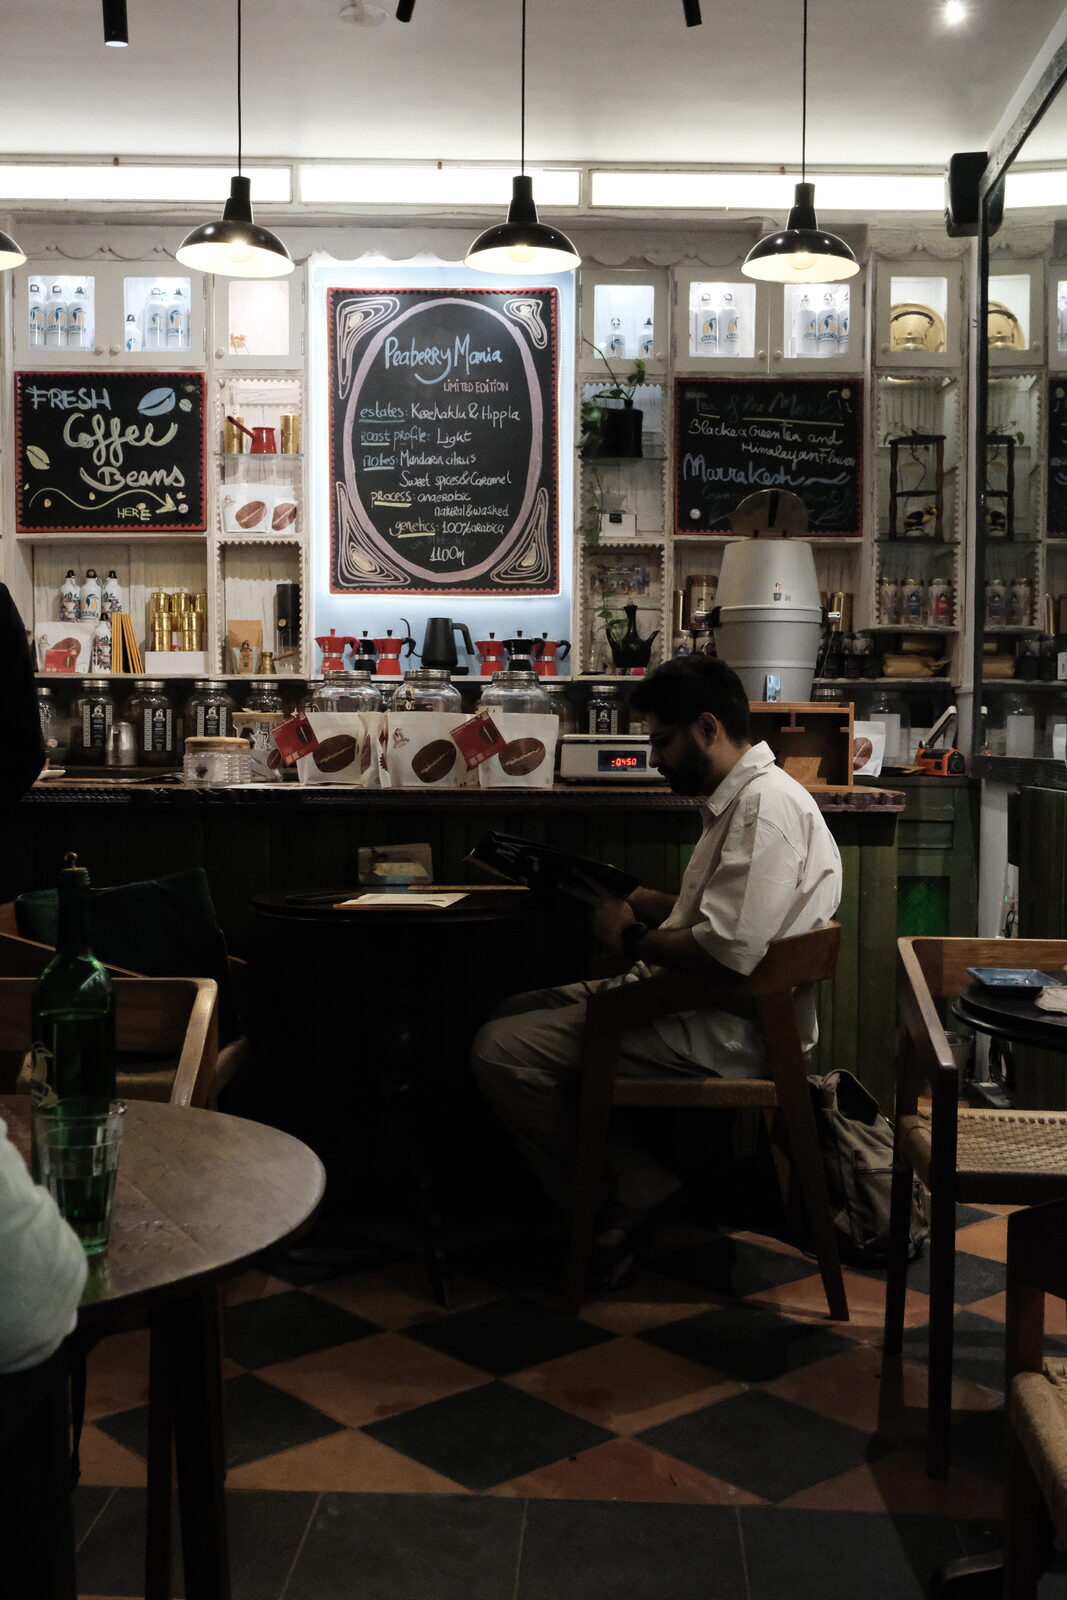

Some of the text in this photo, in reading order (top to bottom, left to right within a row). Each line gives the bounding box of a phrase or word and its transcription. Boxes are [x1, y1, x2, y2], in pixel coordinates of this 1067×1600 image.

[384, 333, 503, 385] Peaberry Mania
[443, 379, 509, 393] LIMITED EDITION
[25, 385, 112, 411] FRESH
[468, 402, 479, 420] &
[63, 412, 179, 468] Coffee
[436, 428, 473, 449] Light
[807, 428, 845, 445] and
[445, 451, 477, 466] citrus
[682, 452, 806, 486] Marrakesh
[79, 464, 186, 493] Beans
[399, 470, 431, 487] Sweet
[417, 491, 472, 503] anaerobic
[117, 507, 152, 521] HERE
